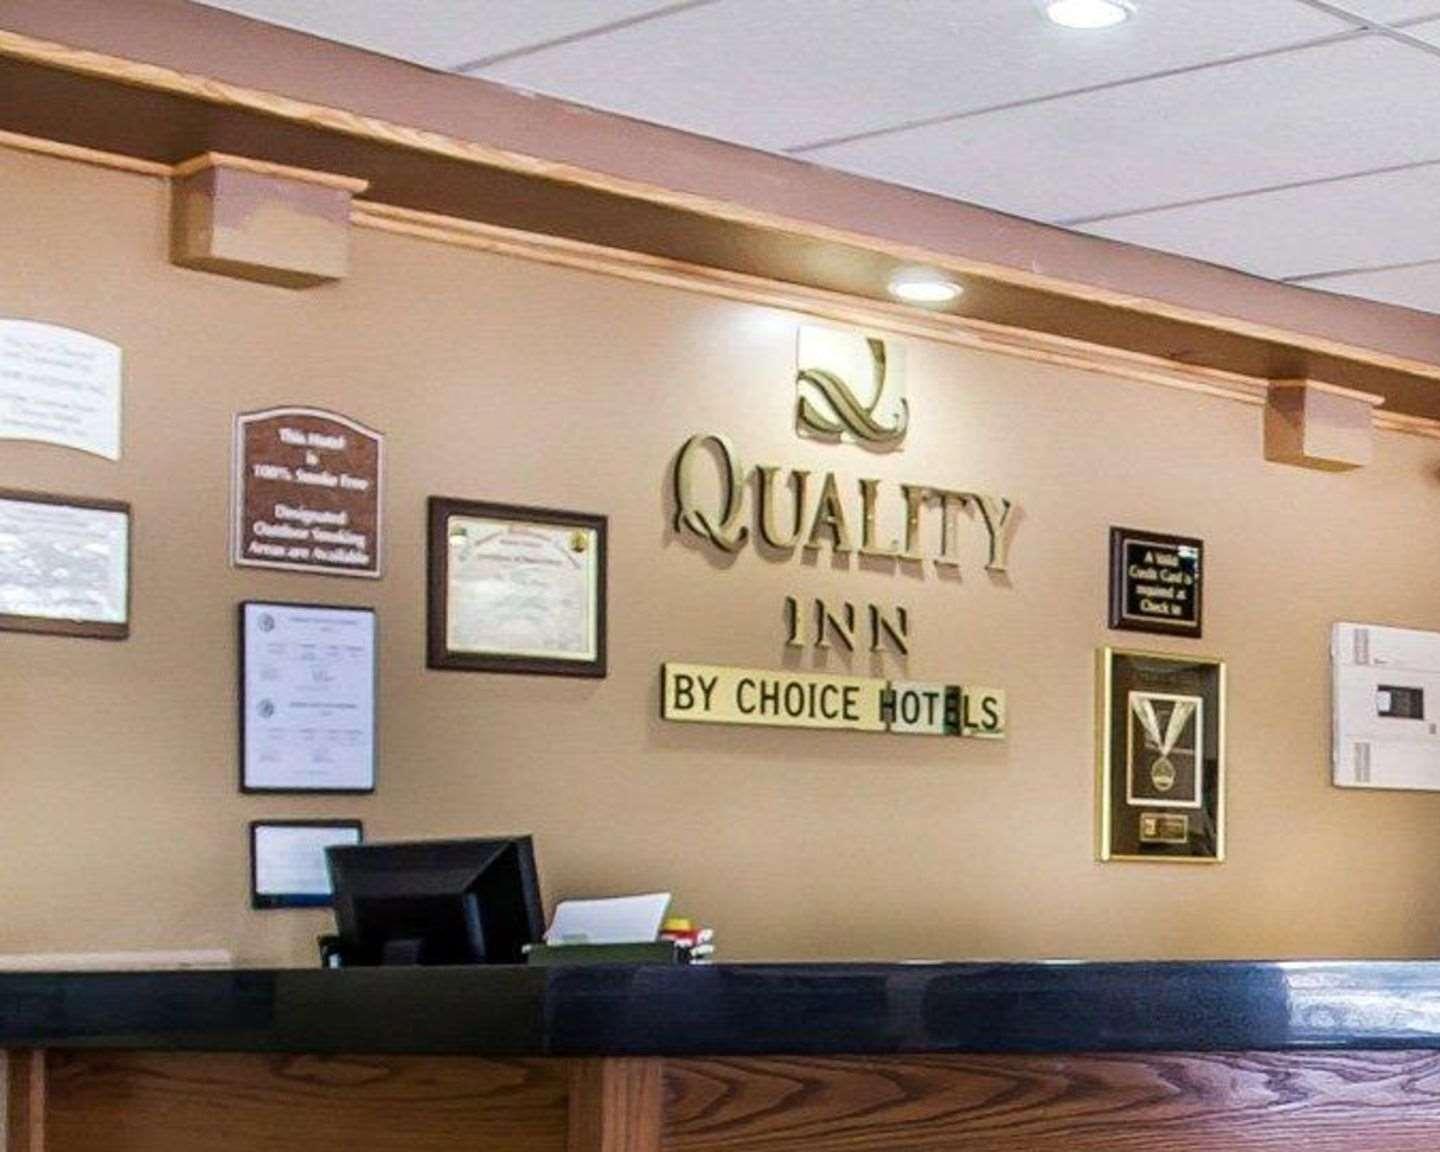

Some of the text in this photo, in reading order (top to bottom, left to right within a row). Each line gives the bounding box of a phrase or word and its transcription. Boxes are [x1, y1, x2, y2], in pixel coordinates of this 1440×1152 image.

[672, 434, 1013, 572] QUALITY
[784, 596, 909, 656] INN
[673, 674, 999, 734] BY CHOICE HOTELS
